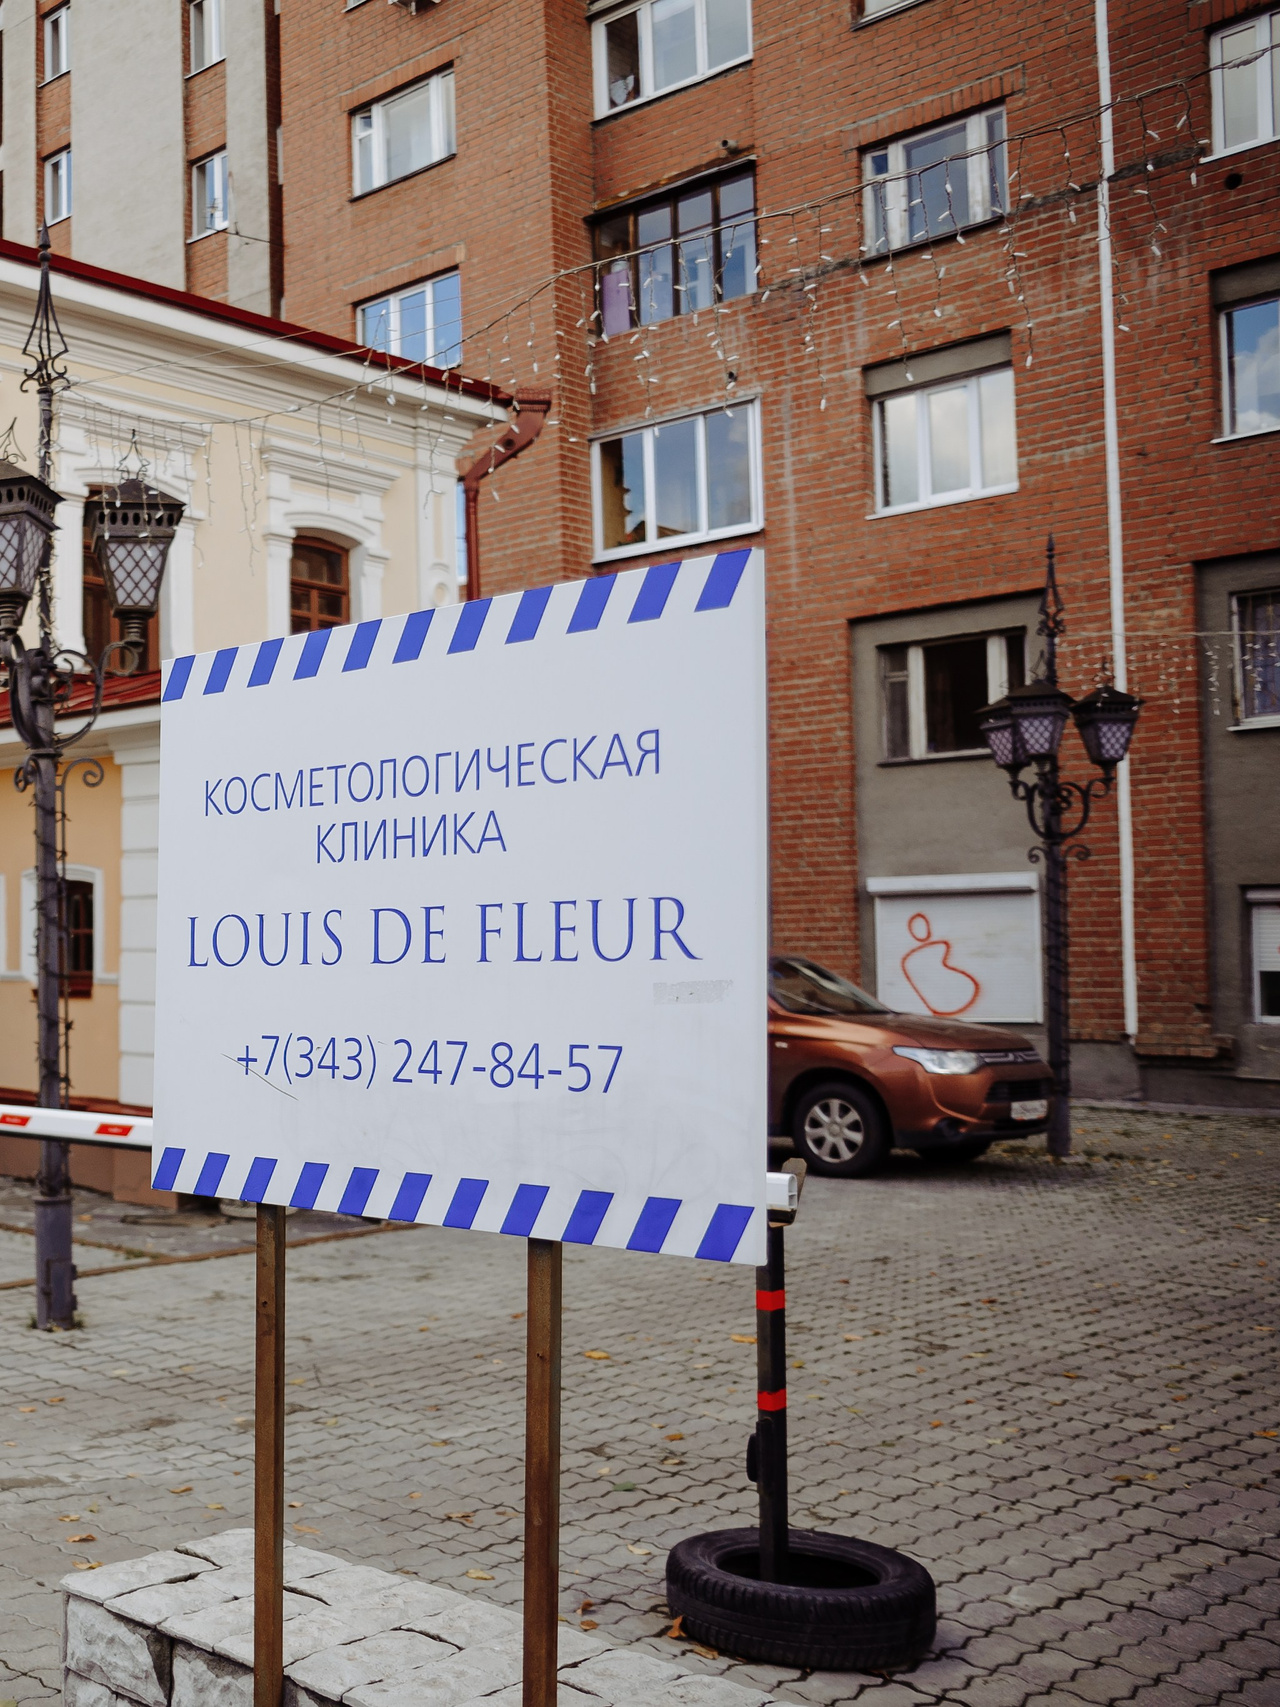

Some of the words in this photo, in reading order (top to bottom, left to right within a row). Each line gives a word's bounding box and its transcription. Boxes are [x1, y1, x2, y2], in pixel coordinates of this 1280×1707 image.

[203, 728, 662, 818] КОСМЕТОЛОГИЧЕСКАЯ
[315, 810, 508, 864] КЛИНИКА
[186, 908, 344, 968] LOUIS
[371, 904, 448, 965] DE
[476, 895, 704, 964] FLEUR
[236, 1034, 378, 1091] +7(343)
[391, 1038, 624, 1094] 247-84-57
